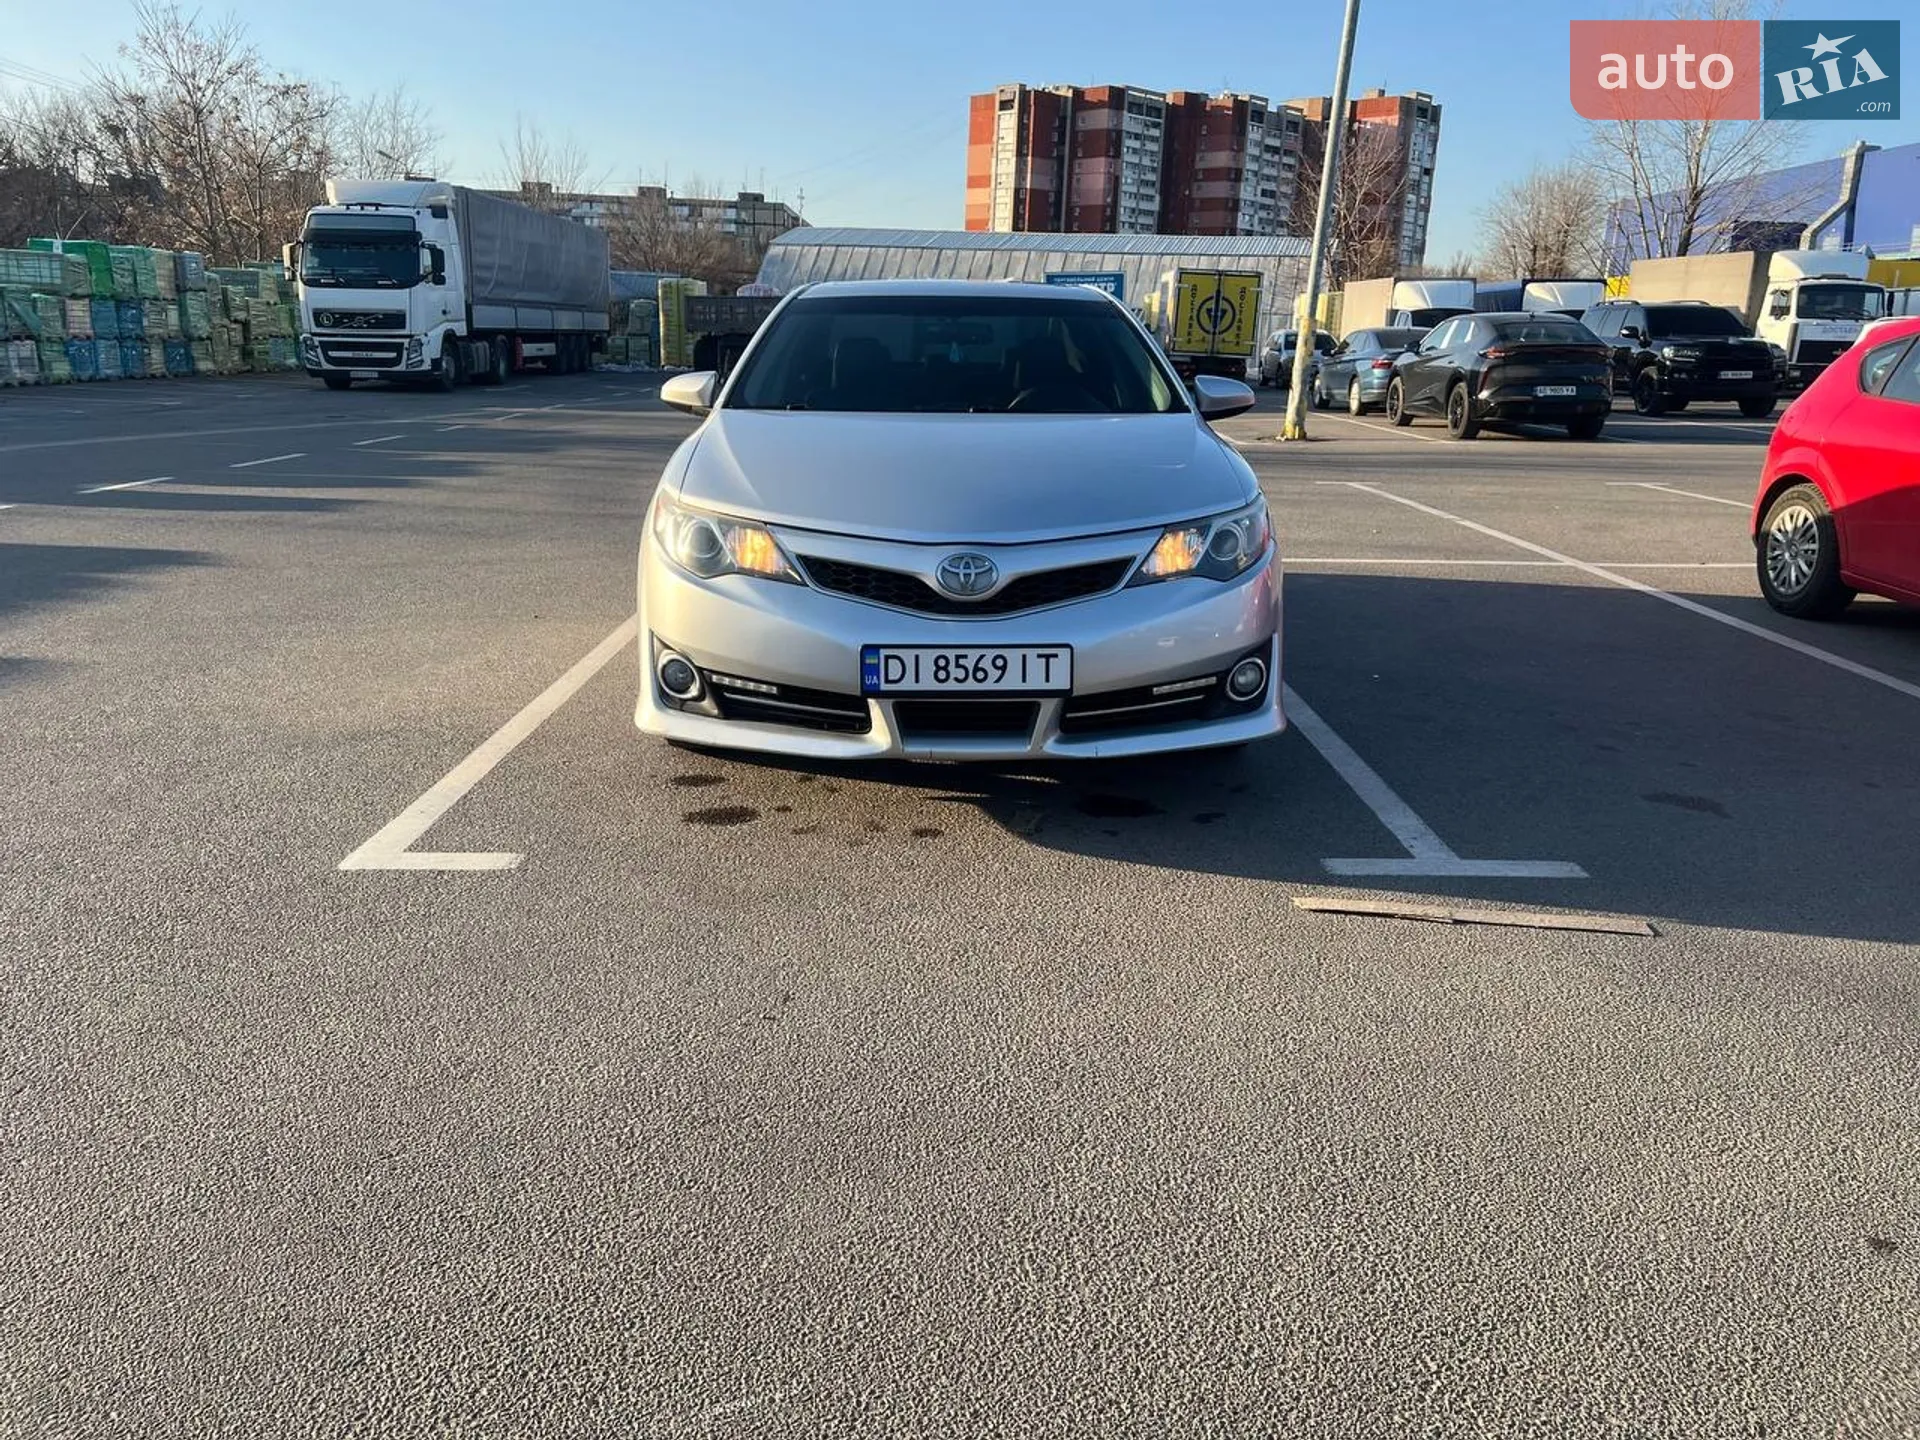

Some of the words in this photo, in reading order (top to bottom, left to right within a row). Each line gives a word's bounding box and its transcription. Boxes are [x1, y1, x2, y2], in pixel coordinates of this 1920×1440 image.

[884, 654, 919, 684] DI
[933, 654, 1008, 684] 8569
[1021, 654, 1059, 684] IT
[865, 674, 879, 685] UA
